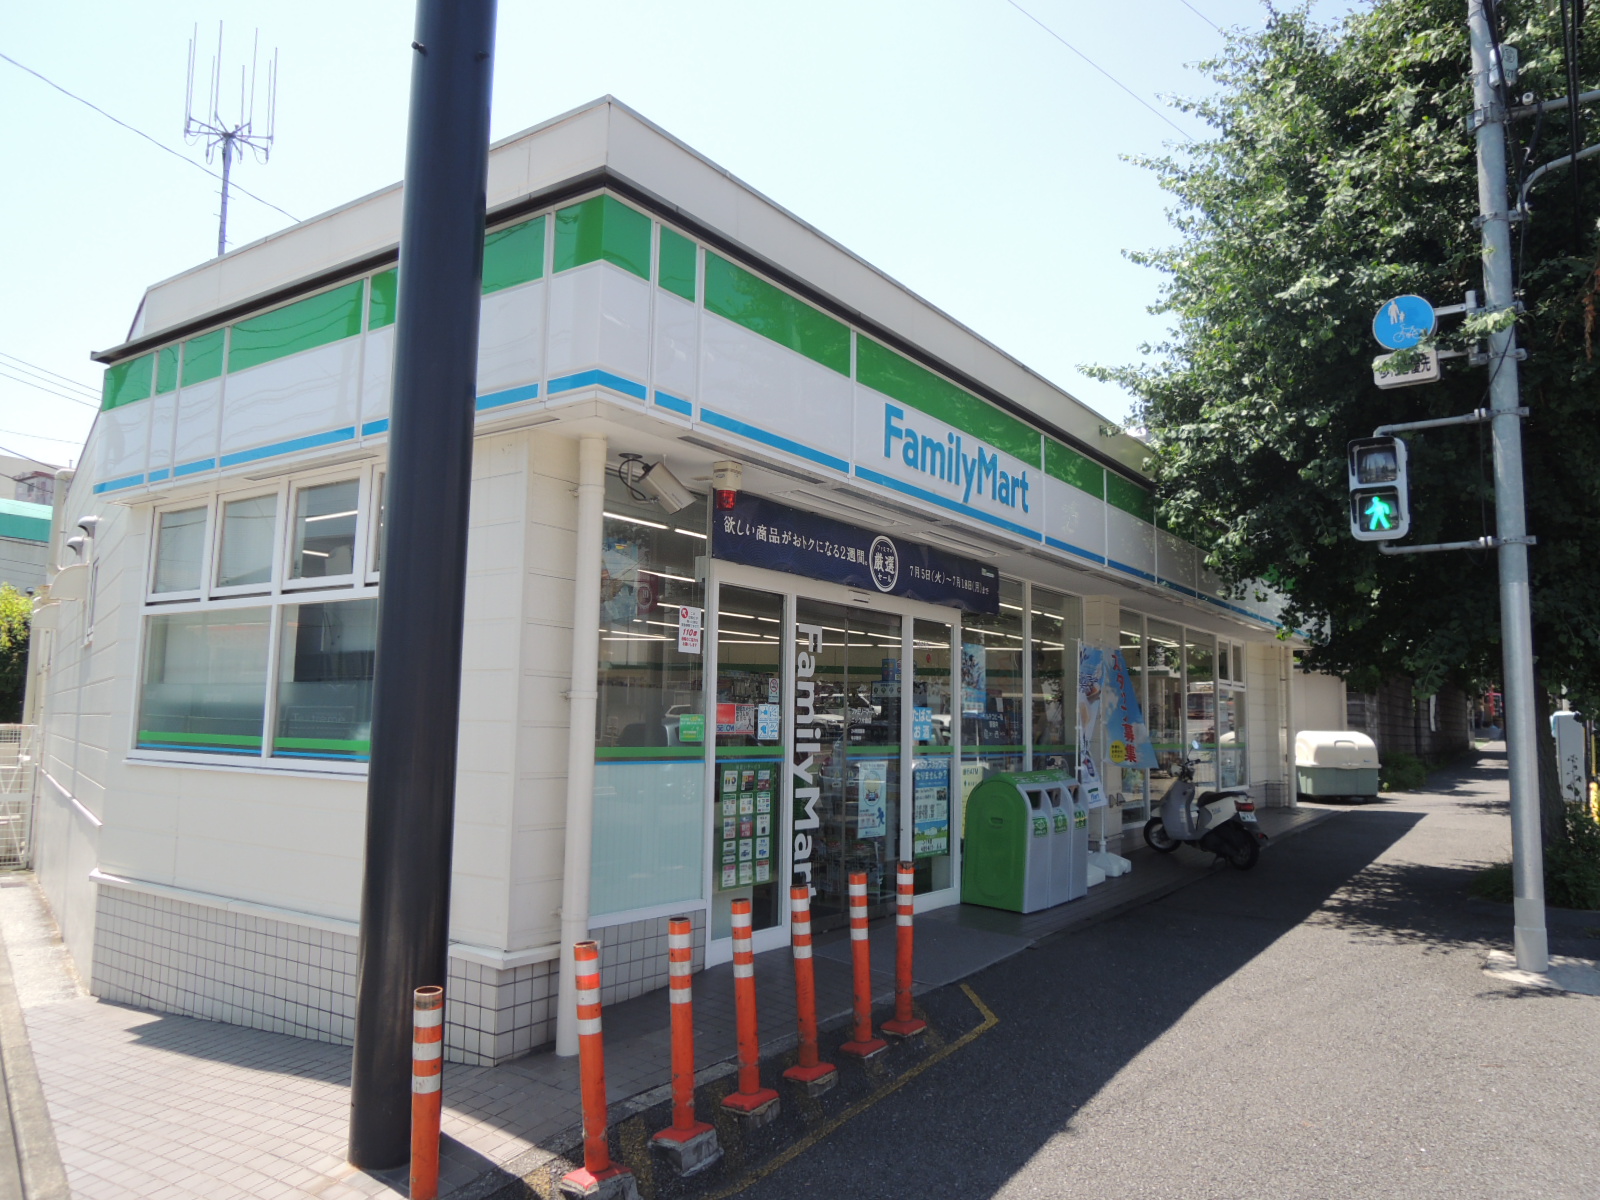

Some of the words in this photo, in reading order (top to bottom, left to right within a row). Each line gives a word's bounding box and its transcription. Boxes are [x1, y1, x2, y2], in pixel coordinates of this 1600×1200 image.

[884, 402, 1029, 513] FamilyMart
[723, 515, 868, 566] 欲しい商品がおトクになる2週間。
[873, 552, 895, 575] 厳選
[877, 573, 892, 583] セール
[794, 623, 823, 904] FamilyMart
